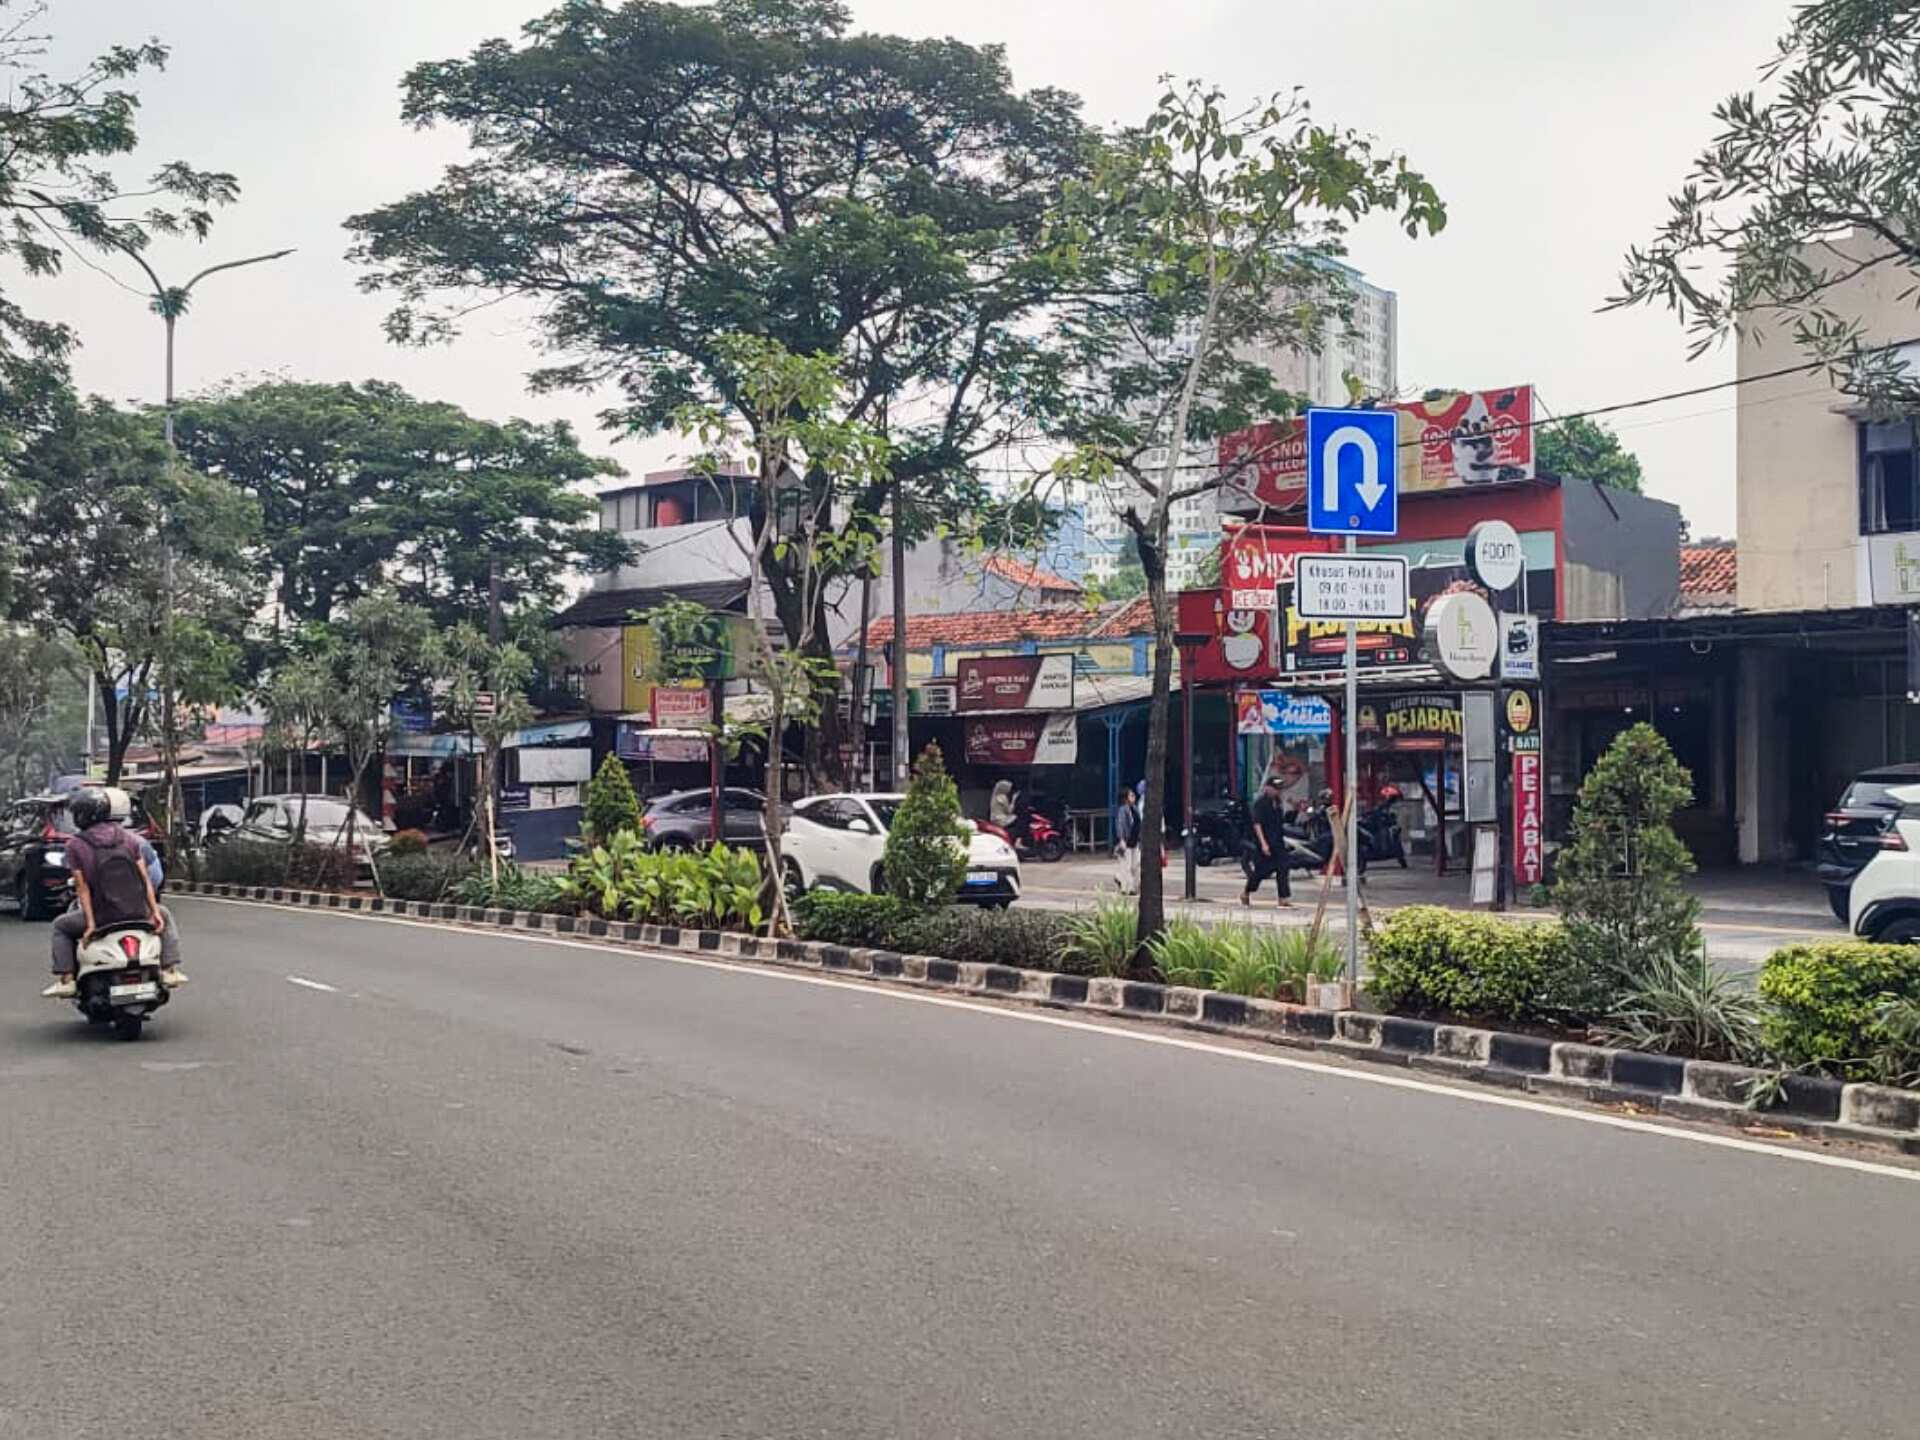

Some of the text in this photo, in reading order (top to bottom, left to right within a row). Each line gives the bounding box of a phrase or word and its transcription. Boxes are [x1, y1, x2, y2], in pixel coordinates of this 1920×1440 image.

[1269, 439, 1304, 459] SNO
[1252, 552, 1295, 578] MIX
[1309, 565, 1395, 578] Khusus Roda Dua
[1386, 706, 1462, 737] PEJABAT
[1521, 755, 1539, 882] PEJABAT
